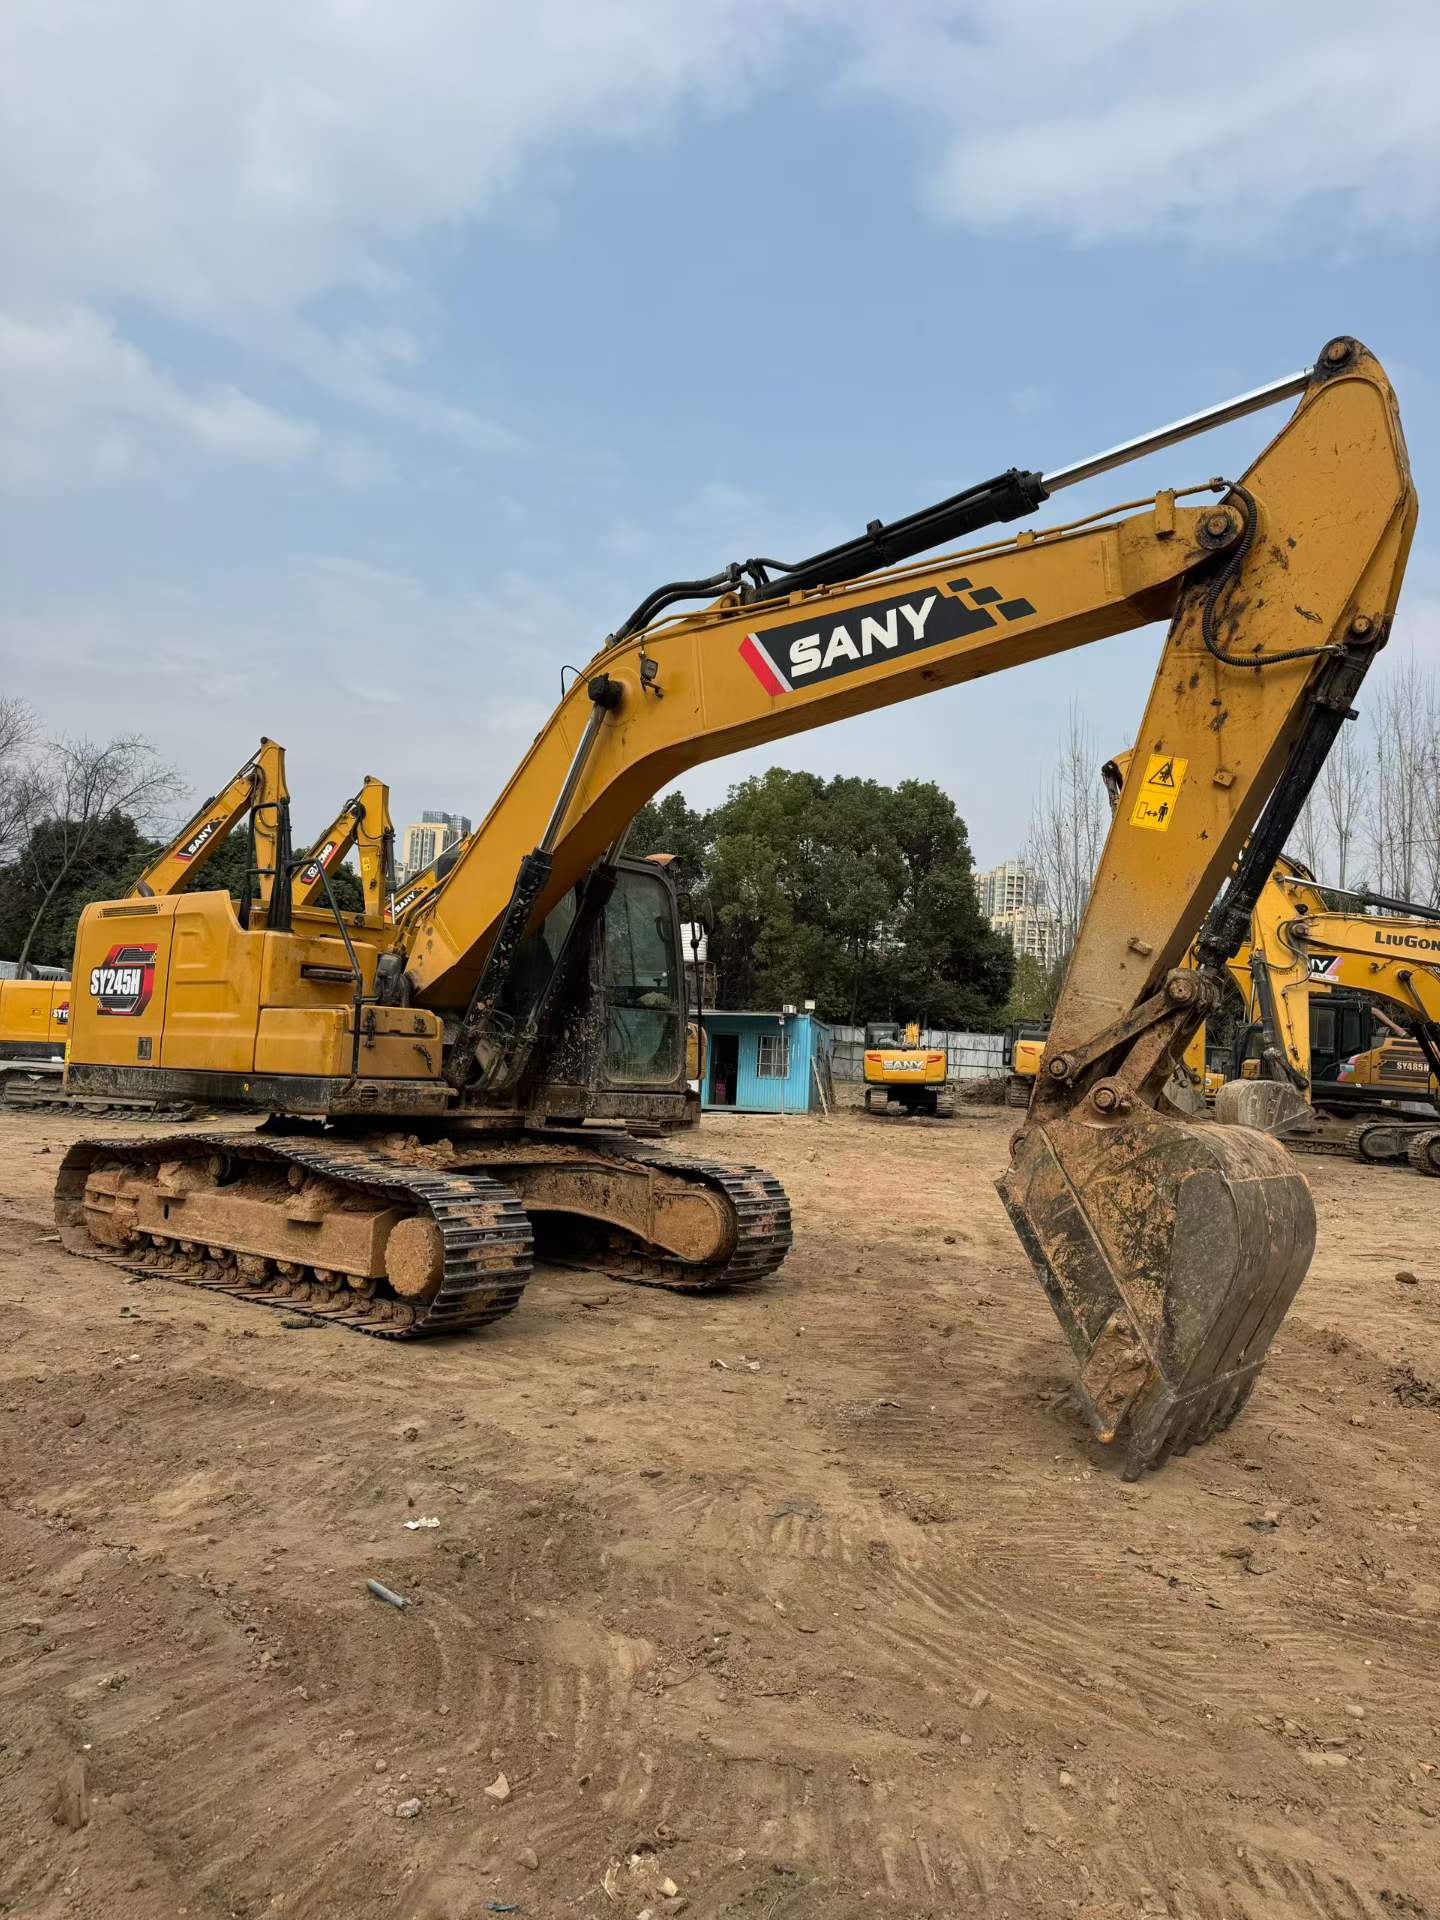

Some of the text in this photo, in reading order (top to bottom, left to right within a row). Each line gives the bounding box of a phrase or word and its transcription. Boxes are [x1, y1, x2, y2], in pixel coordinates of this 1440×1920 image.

[789, 594, 937, 678] SANY
[188, 824, 212, 854] SANY
[394, 891, 415, 912] SANY
[90, 968, 141, 995] SY245H
[884, 1060, 924, 1071] SANY
[1396, 1061, 1429, 1072] SY485H
